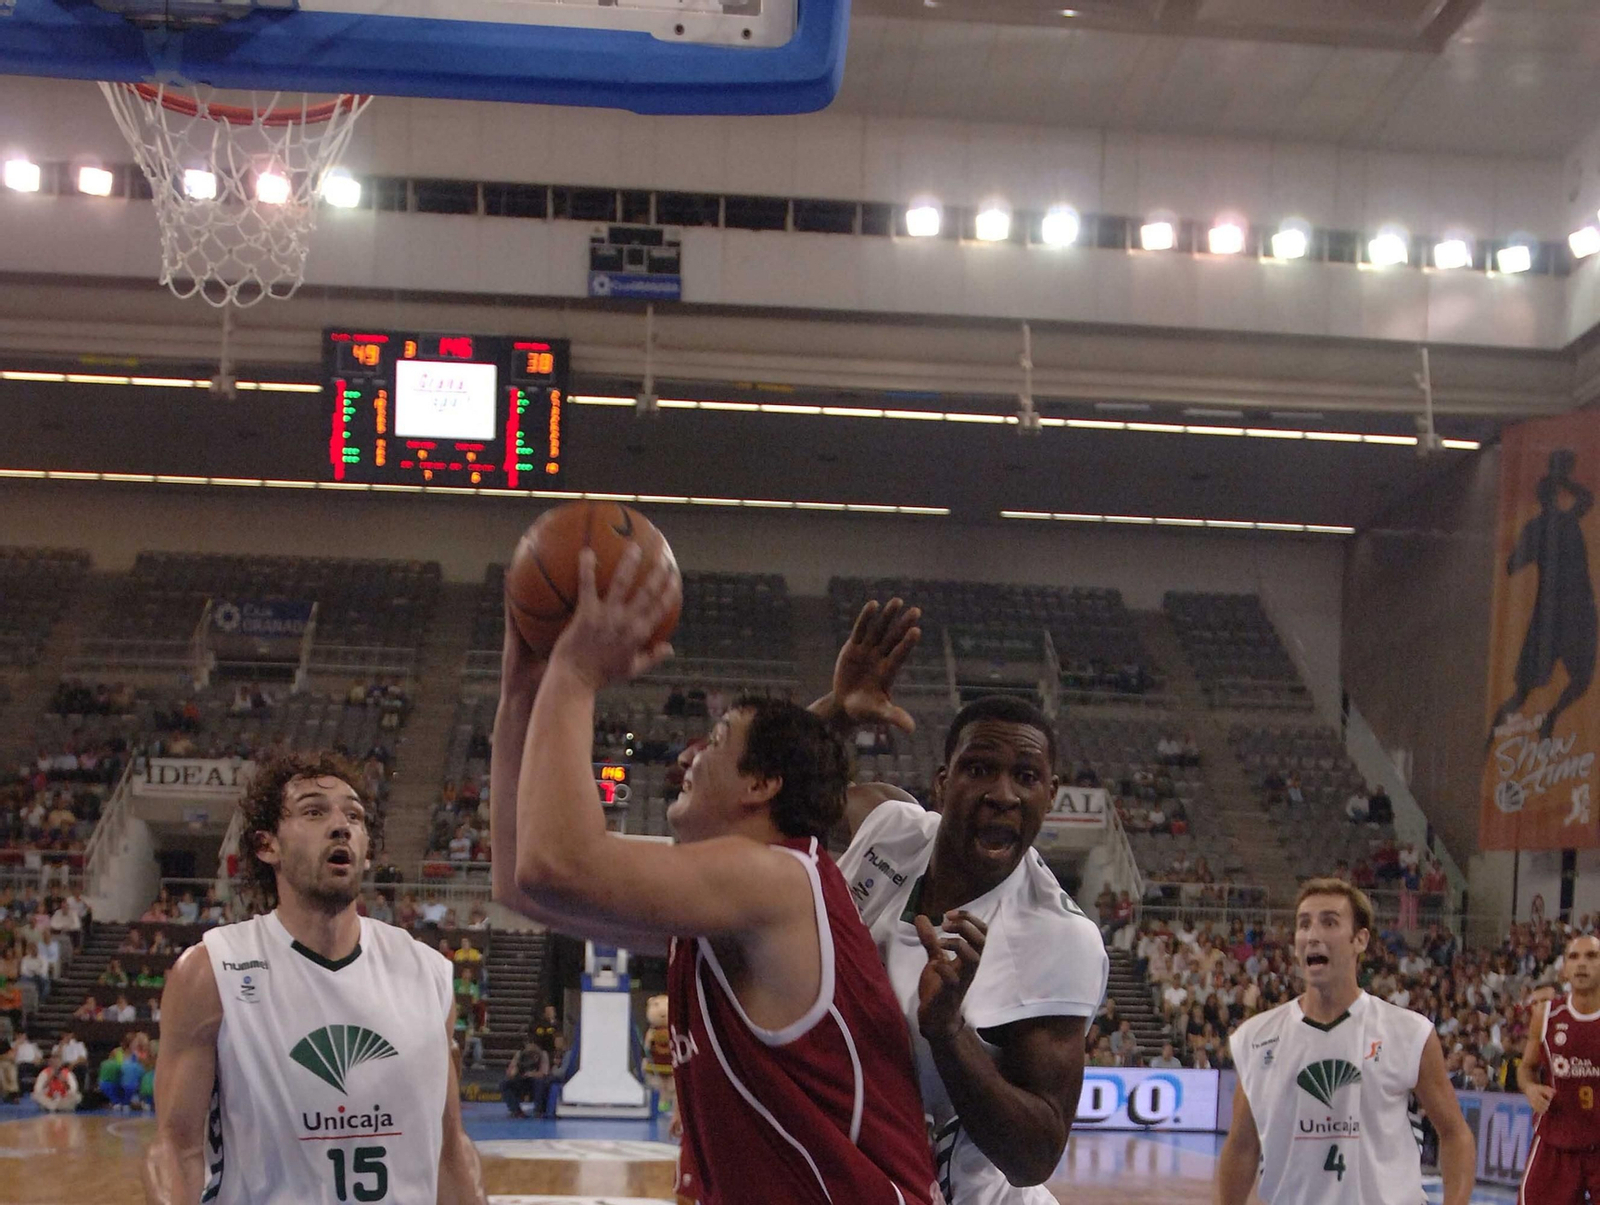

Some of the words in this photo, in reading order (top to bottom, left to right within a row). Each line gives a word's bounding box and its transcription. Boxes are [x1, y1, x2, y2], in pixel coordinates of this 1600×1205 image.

[863, 846, 909, 888] hummel
[222, 960, 269, 971] hummel
[1579, 1085, 1594, 1109] 9
[302, 1104, 394, 1133] Unicaja
[1300, 1116, 1361, 1135] Unicaja
[326, 1145, 388, 1203] 15
[1323, 1144, 1347, 1182] 4
